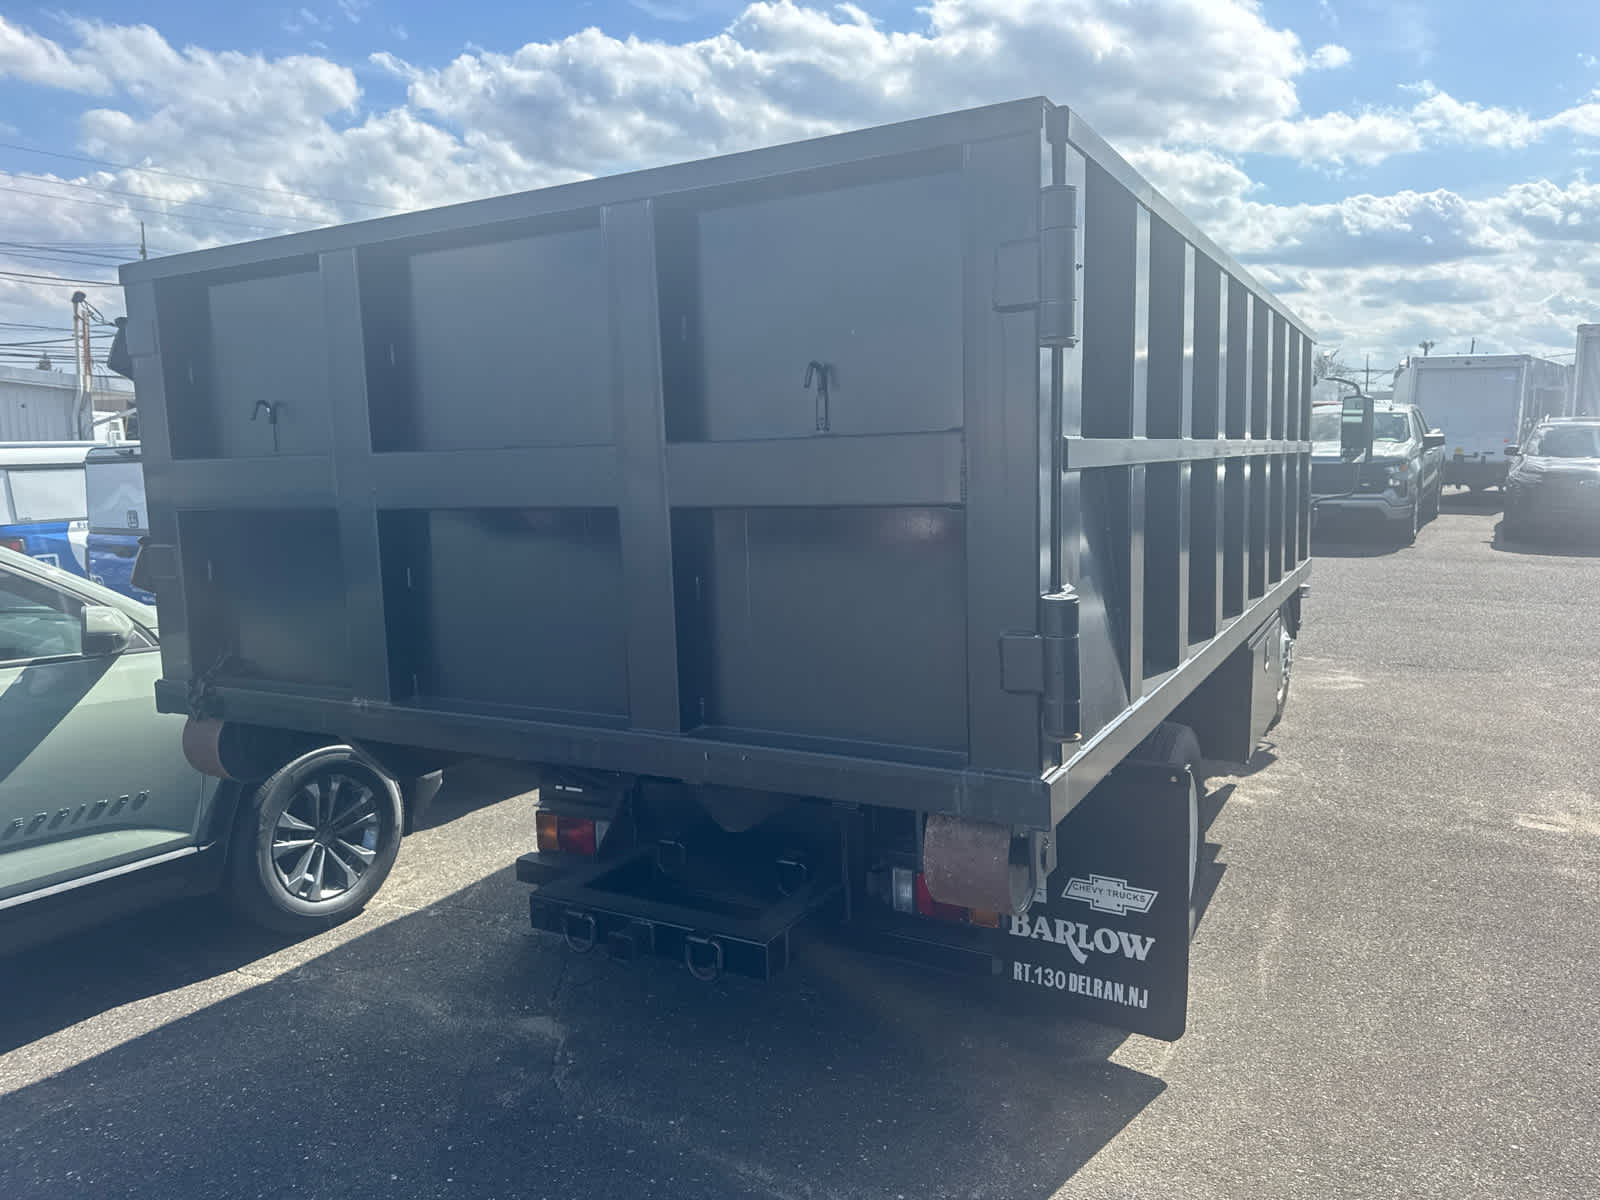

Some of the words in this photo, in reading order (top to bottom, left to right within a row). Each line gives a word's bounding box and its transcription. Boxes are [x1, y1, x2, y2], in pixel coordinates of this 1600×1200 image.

[1072, 883, 1104, 895] CHEVY
[1106, 889, 1147, 903] TRUCKS
[1009, 914, 1156, 965] BARLOW
